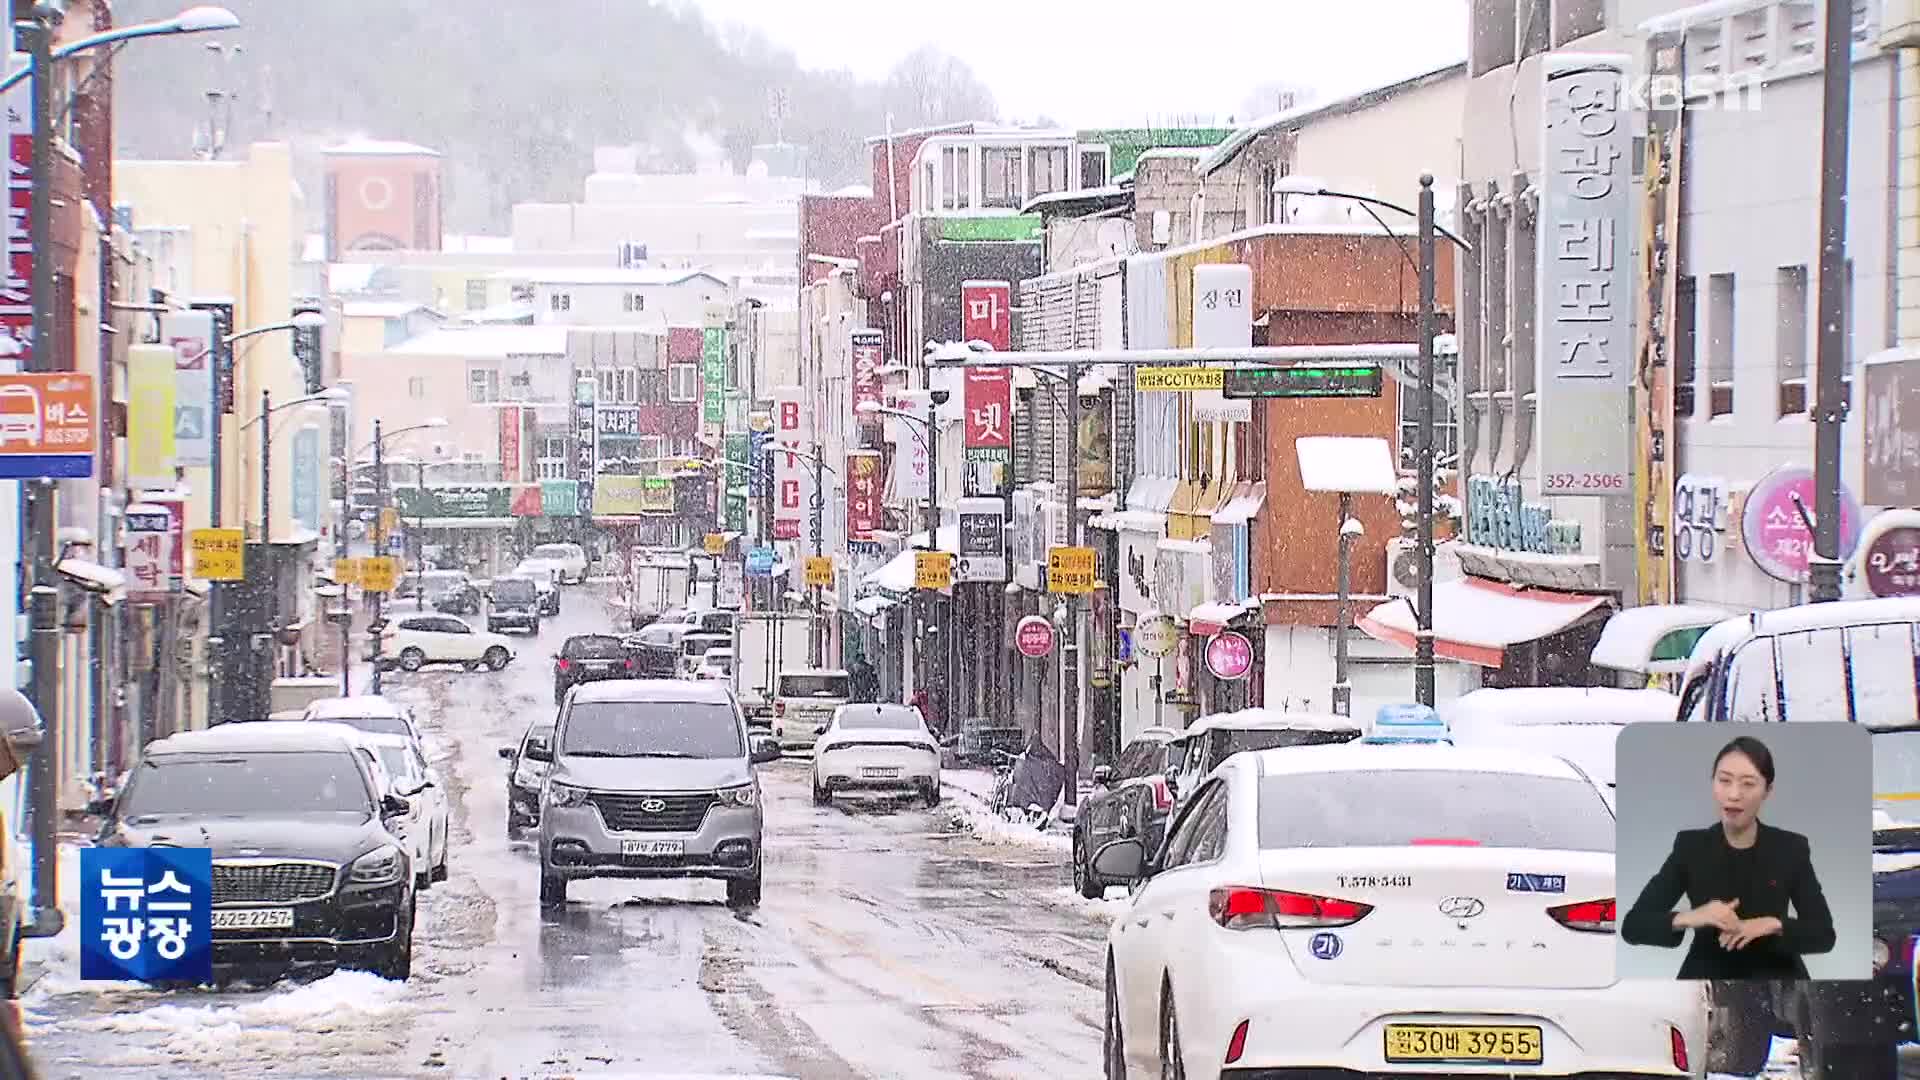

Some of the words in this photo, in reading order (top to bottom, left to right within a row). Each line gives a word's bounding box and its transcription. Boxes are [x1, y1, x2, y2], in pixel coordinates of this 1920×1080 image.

[46, 403, 88, 425] 버스
[780, 401, 799, 509] BYC
[1547, 474, 1623, 489] 352-2506
[131, 535, 162, 587] 세탁
[251, 911, 287, 927] 2257
[1467, 1032, 1532, 1055] 3955
